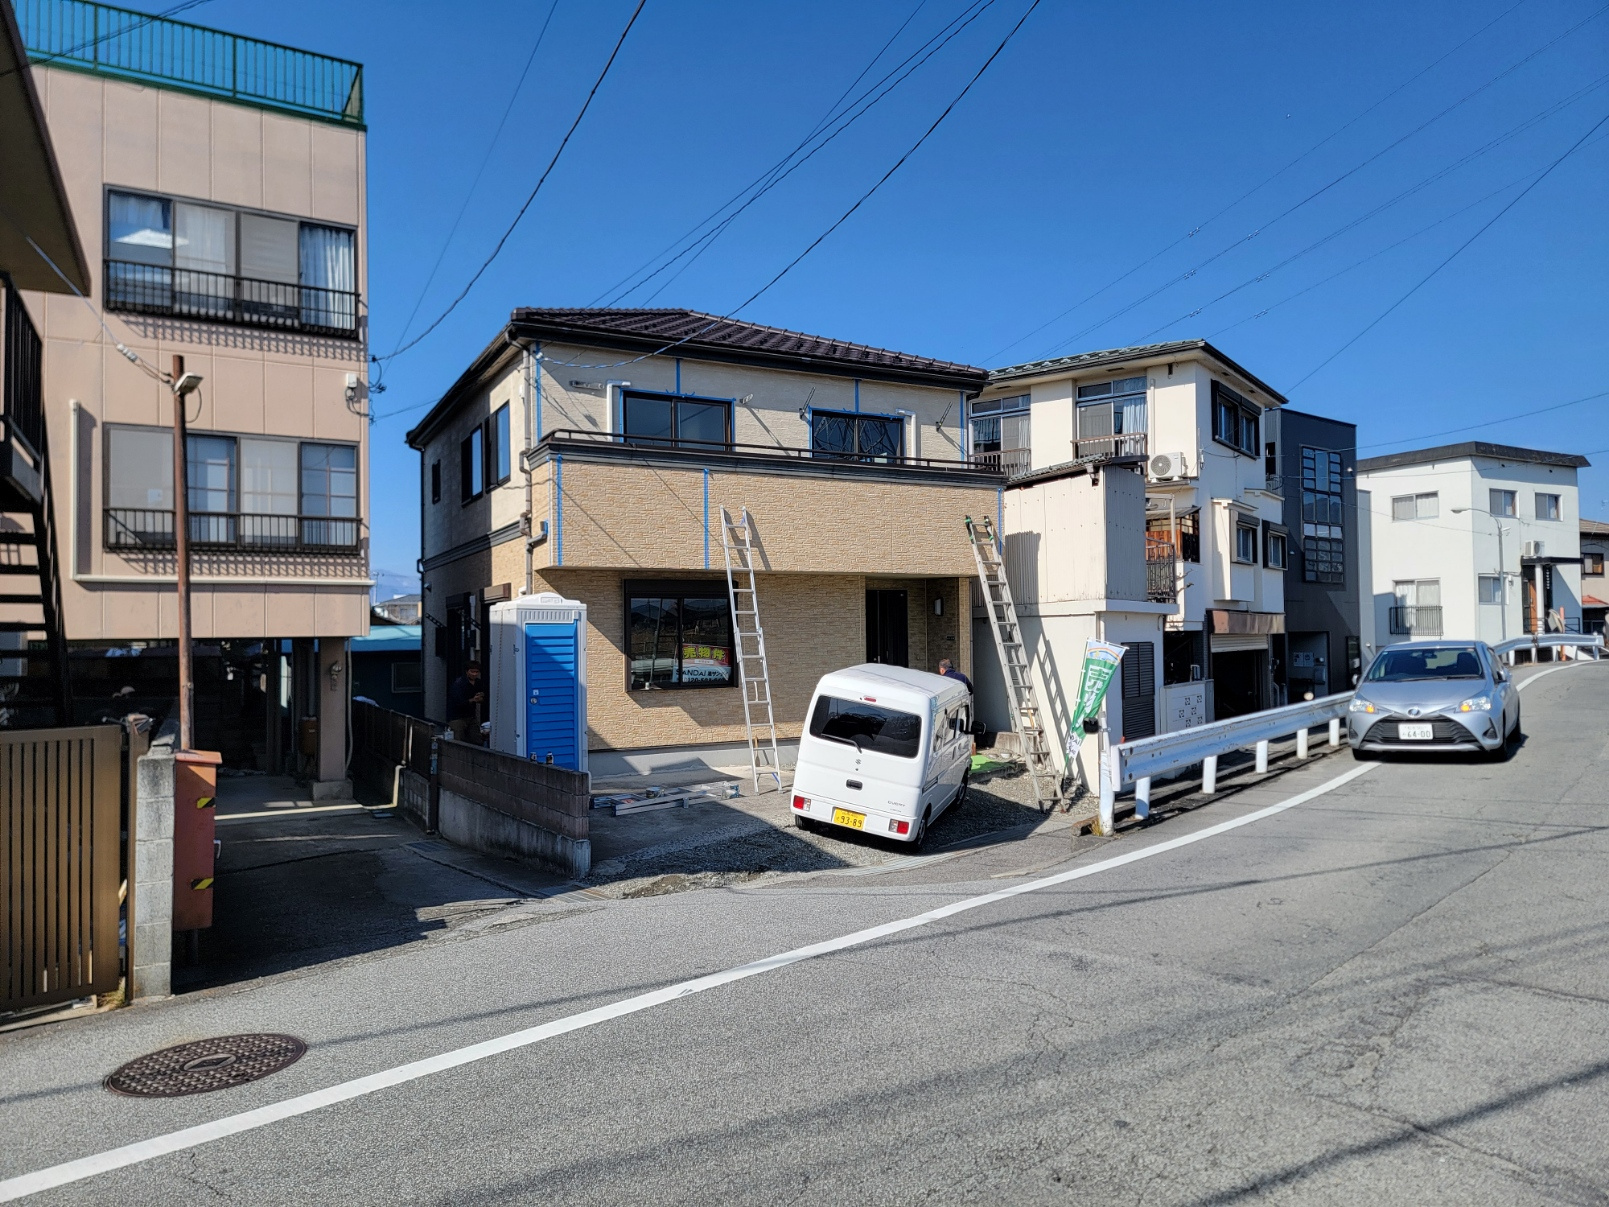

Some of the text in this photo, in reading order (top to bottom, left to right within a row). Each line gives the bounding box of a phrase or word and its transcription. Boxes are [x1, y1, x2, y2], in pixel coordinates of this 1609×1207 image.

[684, 646, 725, 660] 売物件
[840, 816, 863, 828] 93-89
